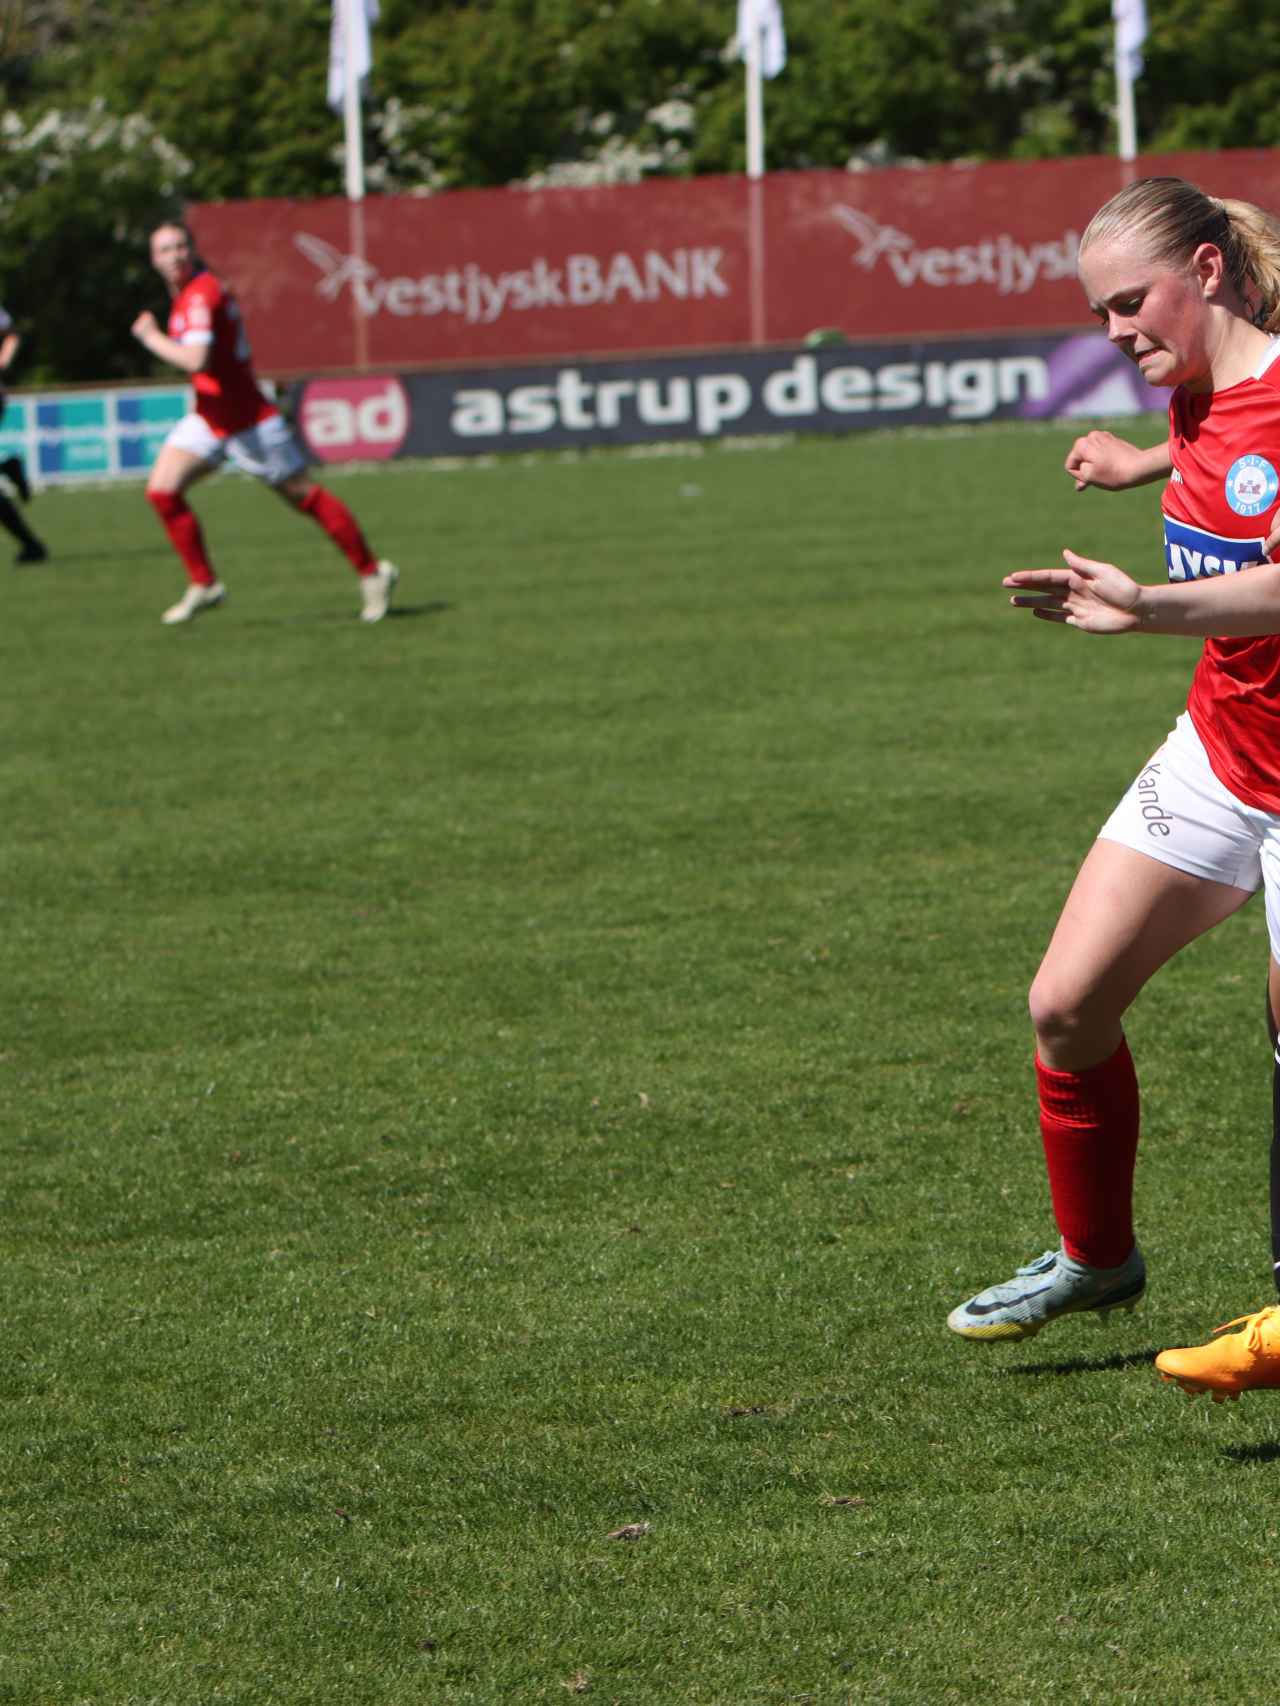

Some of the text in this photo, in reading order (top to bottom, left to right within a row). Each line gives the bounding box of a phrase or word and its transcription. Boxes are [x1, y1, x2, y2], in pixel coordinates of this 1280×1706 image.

[302, 354, 1049, 446] ad astrup design
